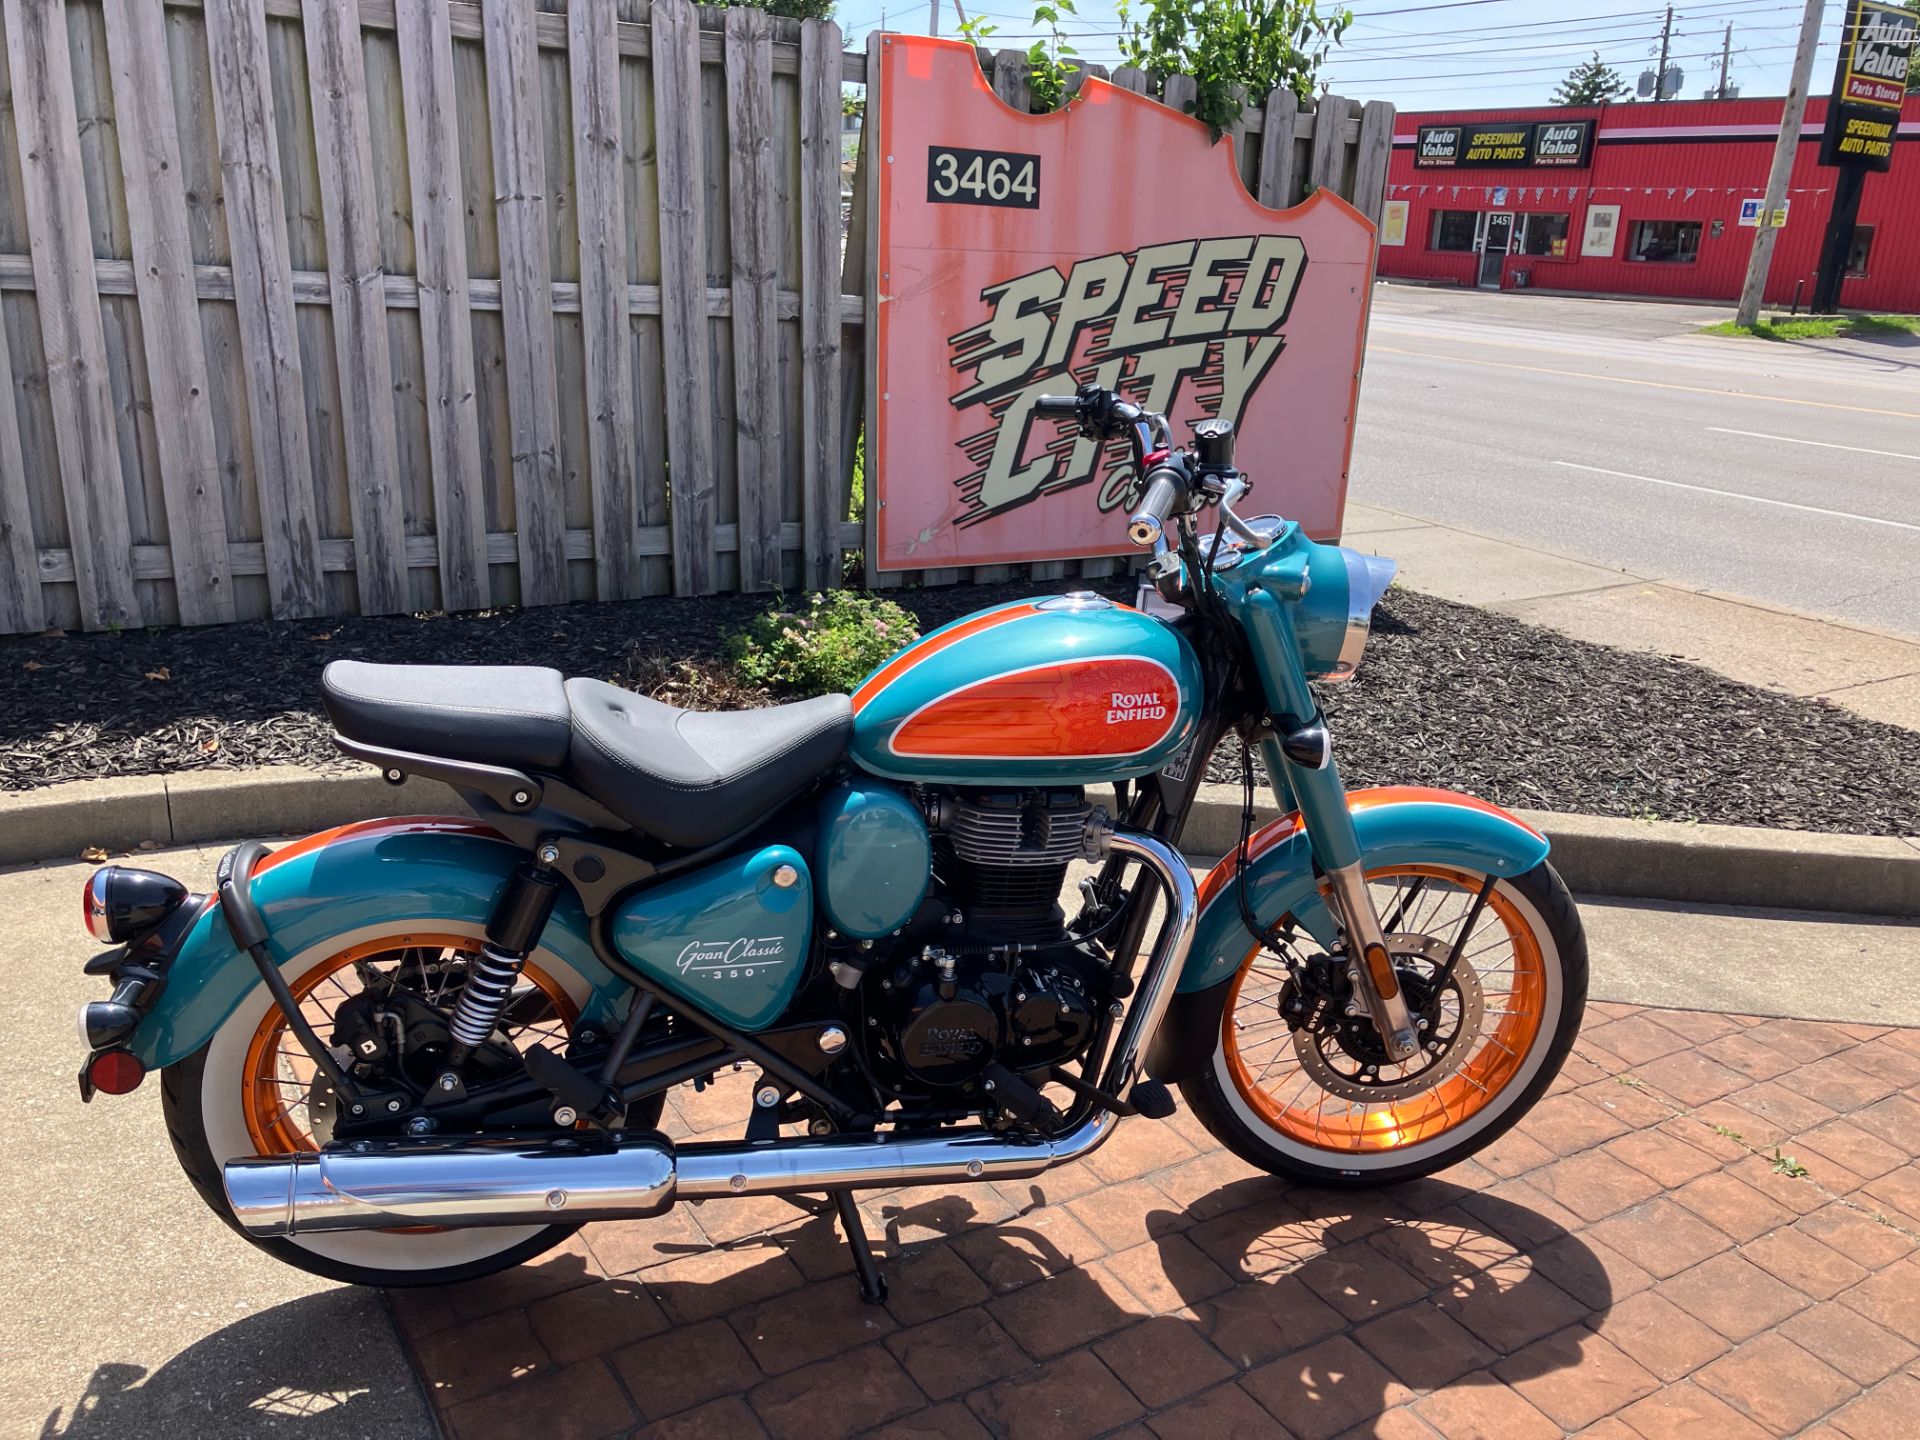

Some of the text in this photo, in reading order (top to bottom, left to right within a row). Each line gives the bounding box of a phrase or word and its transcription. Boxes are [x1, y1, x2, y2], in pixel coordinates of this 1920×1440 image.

[1861, 11, 1912, 50] Auto
[1853, 41, 1909, 79] Value
[1851, 80, 1900, 101] Parts Stores
[1425, 130, 1455, 144] Auto
[1543, 127, 1578, 141] Auto
[1846, 119, 1893, 138] SPEEDWAY
[1472, 132, 1526, 145] SPEEDWAY
[1839, 137, 1892, 157] AUTO PARTS
[1422, 143, 1454, 156] Value
[1466, 147, 1526, 160] AUTO PARTS
[1540, 141, 1576, 155] Value
[933, 153, 1037, 202] 3464
[1491, 215, 1511, 226] 3451
[962, 234, 1309, 394] SPEED
[962, 334, 1287, 513] CITY
[1111, 692, 1161, 708] ROYAL
[1106, 706, 1167, 724] ENFIELD
[676, 937, 784, 975] Goan Classic
[927, 1027, 977, 1042] ROYAL
